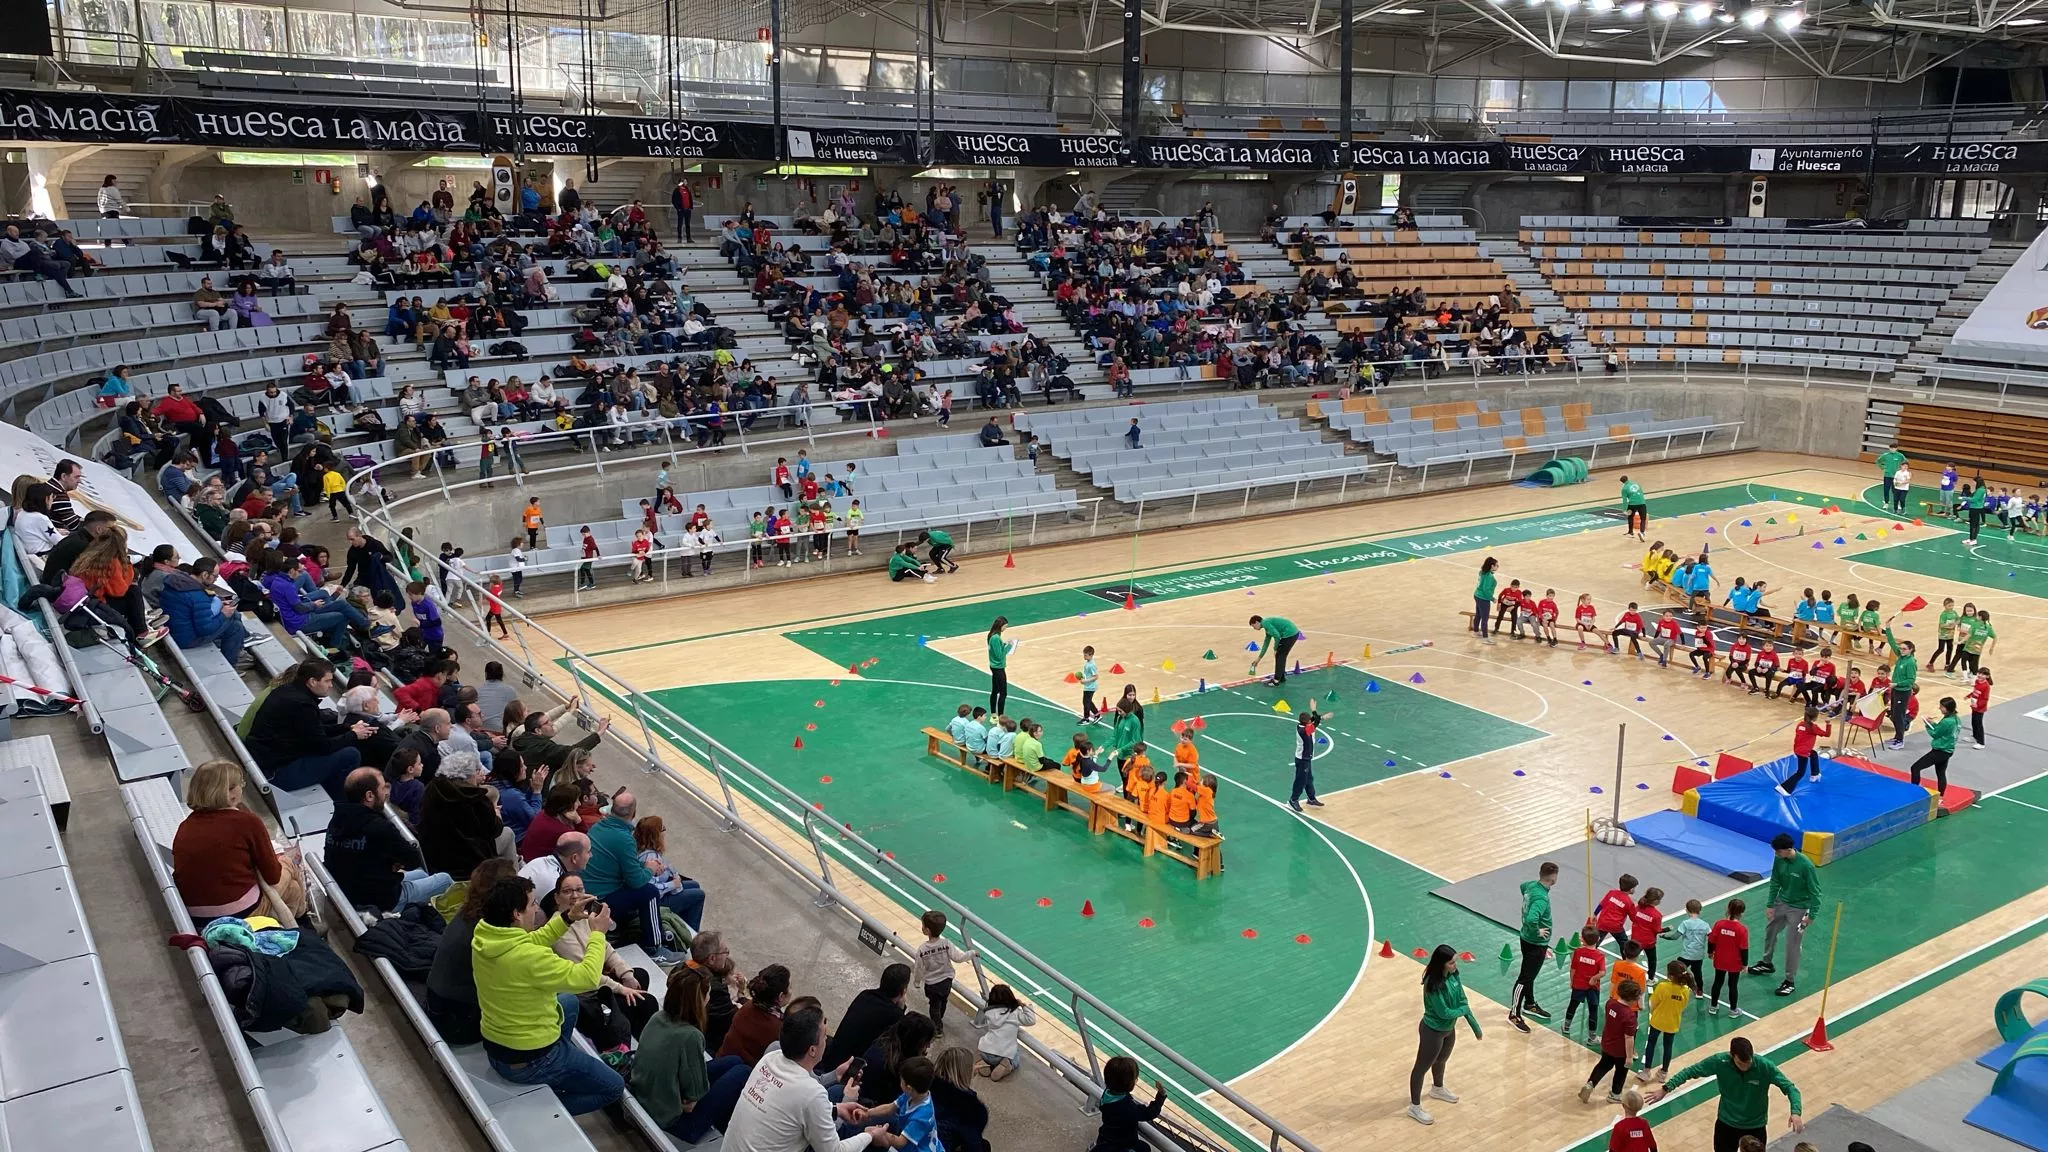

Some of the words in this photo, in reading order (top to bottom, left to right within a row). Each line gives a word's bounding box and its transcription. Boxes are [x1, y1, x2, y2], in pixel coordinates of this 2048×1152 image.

[332, 118, 371, 140] La
[815, 131, 894, 147] Ayuntamiento
[817, 148, 832, 159] de
[834, 147, 878, 160] Huesca
[974, 155, 986, 165] La
[1230, 146, 1251, 163] La
[1409, 150, 1431, 165] La
[1780, 147, 1863, 161] Ayuntamiento
[1074, 157, 1086, 166] La
[1525, 162, 1536, 172] La
[1622, 163, 1634, 173] La
[1779, 160, 1794, 171] de
[1797, 160, 1841, 171] Huesca
[1946, 163, 1961, 172] La
[1294, 550, 1398, 570] Hacemos
[1408, 533, 1489, 553] deporte
[1135, 563, 1268, 590] Ayuntamiento
[1153, 584, 1178, 596] de
[1180, 573, 1259, 592] Huesca
[759, 1064, 771, 1079] See
[768, 1076, 784, 1089] you
[747, 1086, 765, 1104] there
